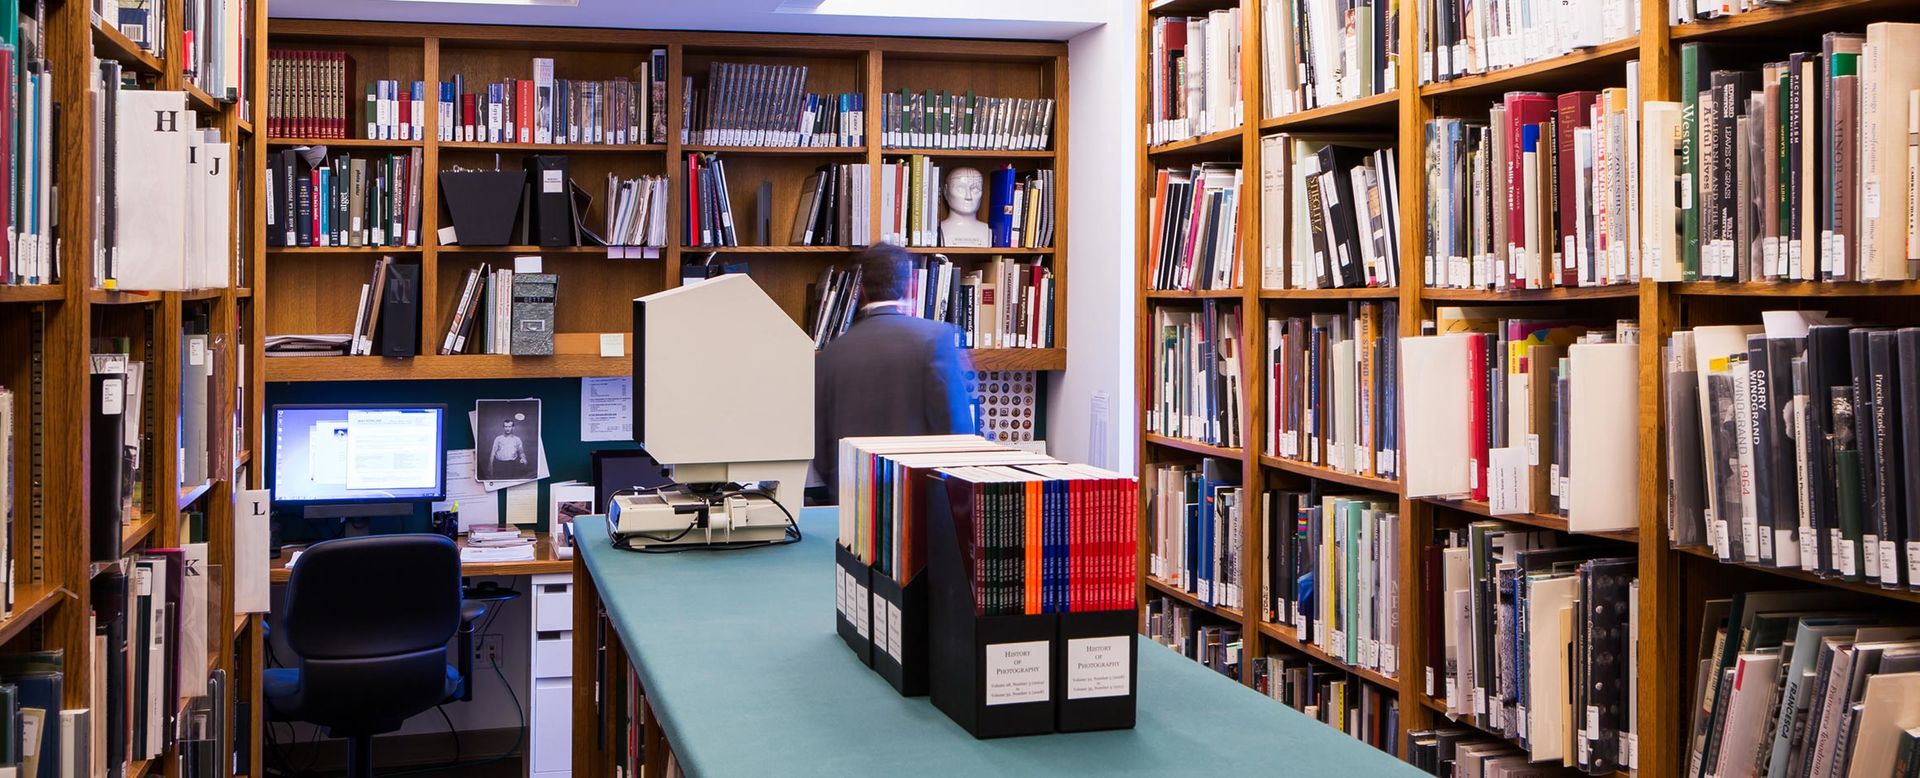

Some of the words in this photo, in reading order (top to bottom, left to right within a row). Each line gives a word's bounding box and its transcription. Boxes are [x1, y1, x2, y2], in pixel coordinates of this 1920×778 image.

[154, 110, 179, 133] H
[1682, 104, 1695, 165] Weston
[1703, 107, 1713, 153] Artful
[189, 146, 198, 164] I
[1724, 126, 1732, 156] LEAVES
[1835, 120, 1844, 174] MINOR
[1870, 123, 1878, 173] manifestations
[209, 157, 220, 176] J
[1703, 156, 1713, 190] Lives
[1724, 157, 1732, 169] OF
[1724, 170, 1732, 199] GRASS
[340, 191, 350, 212] atget
[1310, 175, 1322, 232] STIEGLITZ
[1835, 179, 1844, 235] WHITE
[1868, 243, 1877, 263] white
[1756, 369, 1767, 411] GARRY
[1875, 374, 1884, 405] Przeciw
[1735, 377, 1749, 455] WINOGRAND
[1749, 370, 1760, 445] WINOGRAND
[1876, 406, 1886, 436] Nicości
[1741, 463, 1750, 496] 1964
[253, 501, 266, 516] L
[184, 558, 200, 577] K
[1005, 650, 1031, 658] HISTORY
[1086, 645, 1112, 653] HISTORY
[996, 666, 1039, 676] PHOTOGRAPHY
[1077, 660, 1121, 670] PHOTOGRAPHY
[1780, 682, 1797, 740] FRANCESCA
[1822, 685, 1838, 732] Francesca
